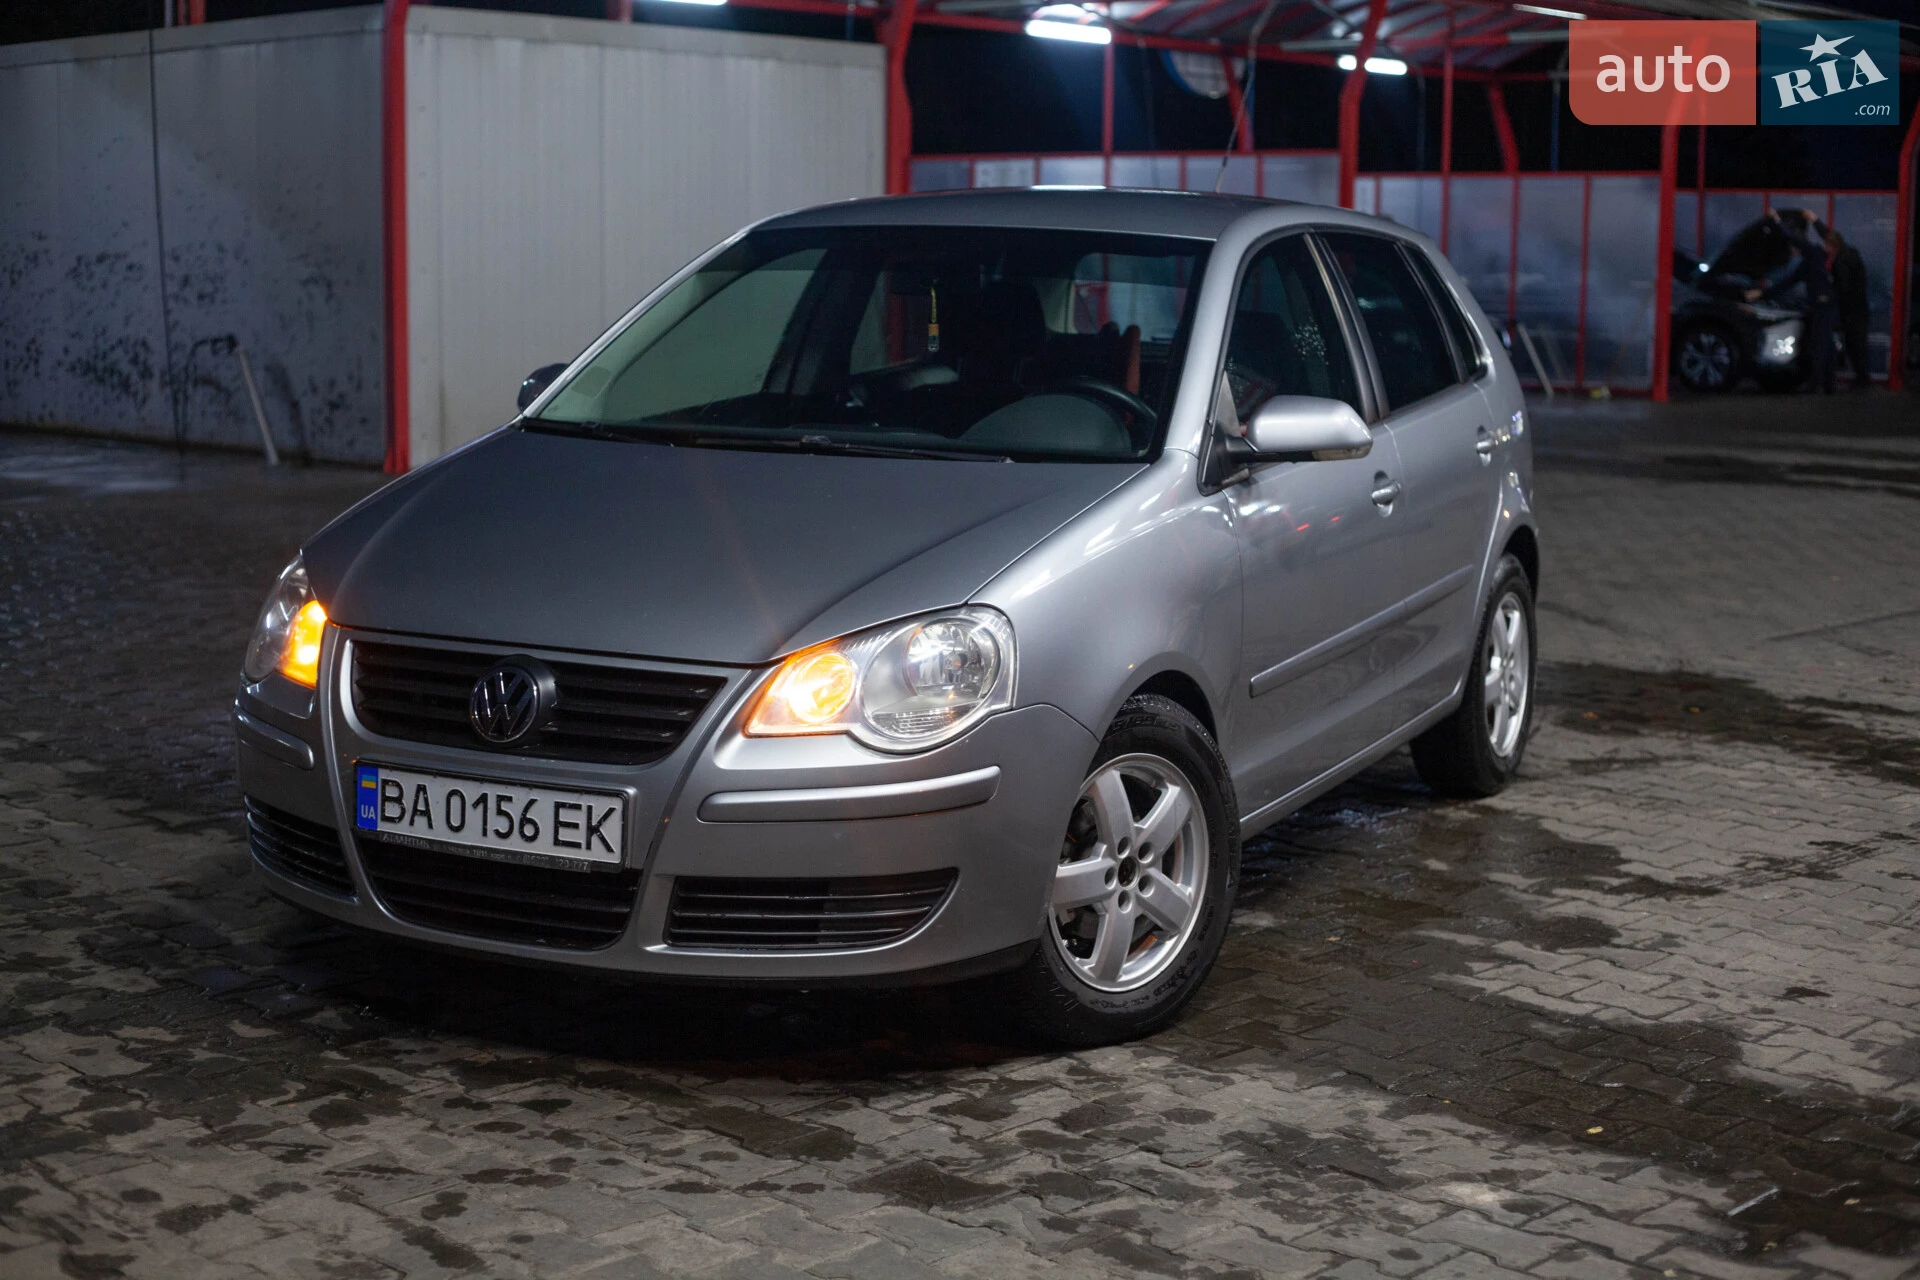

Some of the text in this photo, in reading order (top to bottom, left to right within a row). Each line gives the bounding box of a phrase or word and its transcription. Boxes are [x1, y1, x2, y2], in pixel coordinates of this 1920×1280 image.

[361, 805, 376, 820] UA
[380, 778, 616, 853] BA 0156 EK
